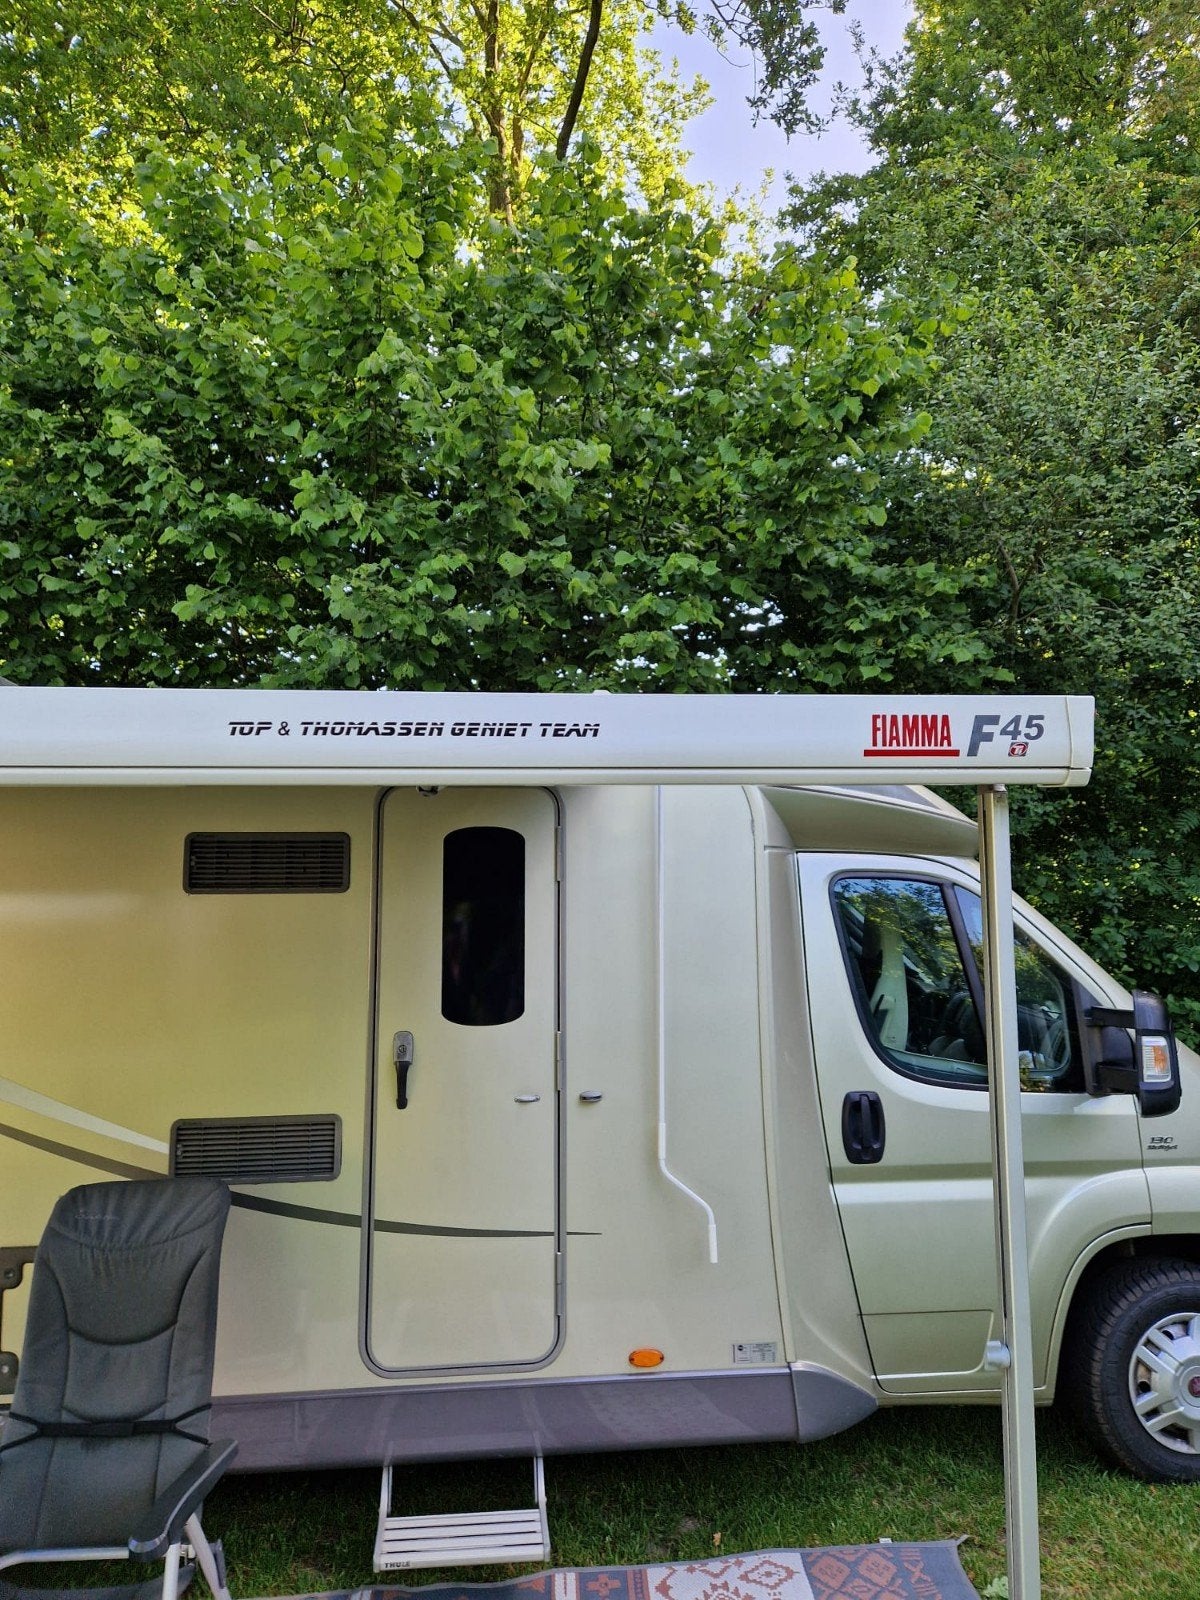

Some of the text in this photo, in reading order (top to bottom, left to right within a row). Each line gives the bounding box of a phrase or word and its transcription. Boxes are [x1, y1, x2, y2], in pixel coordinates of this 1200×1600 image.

[228, 721, 600, 738] TOP & THOMASSEN GENIET TEAM
[872, 714, 1045, 757] FIAMMA F45
